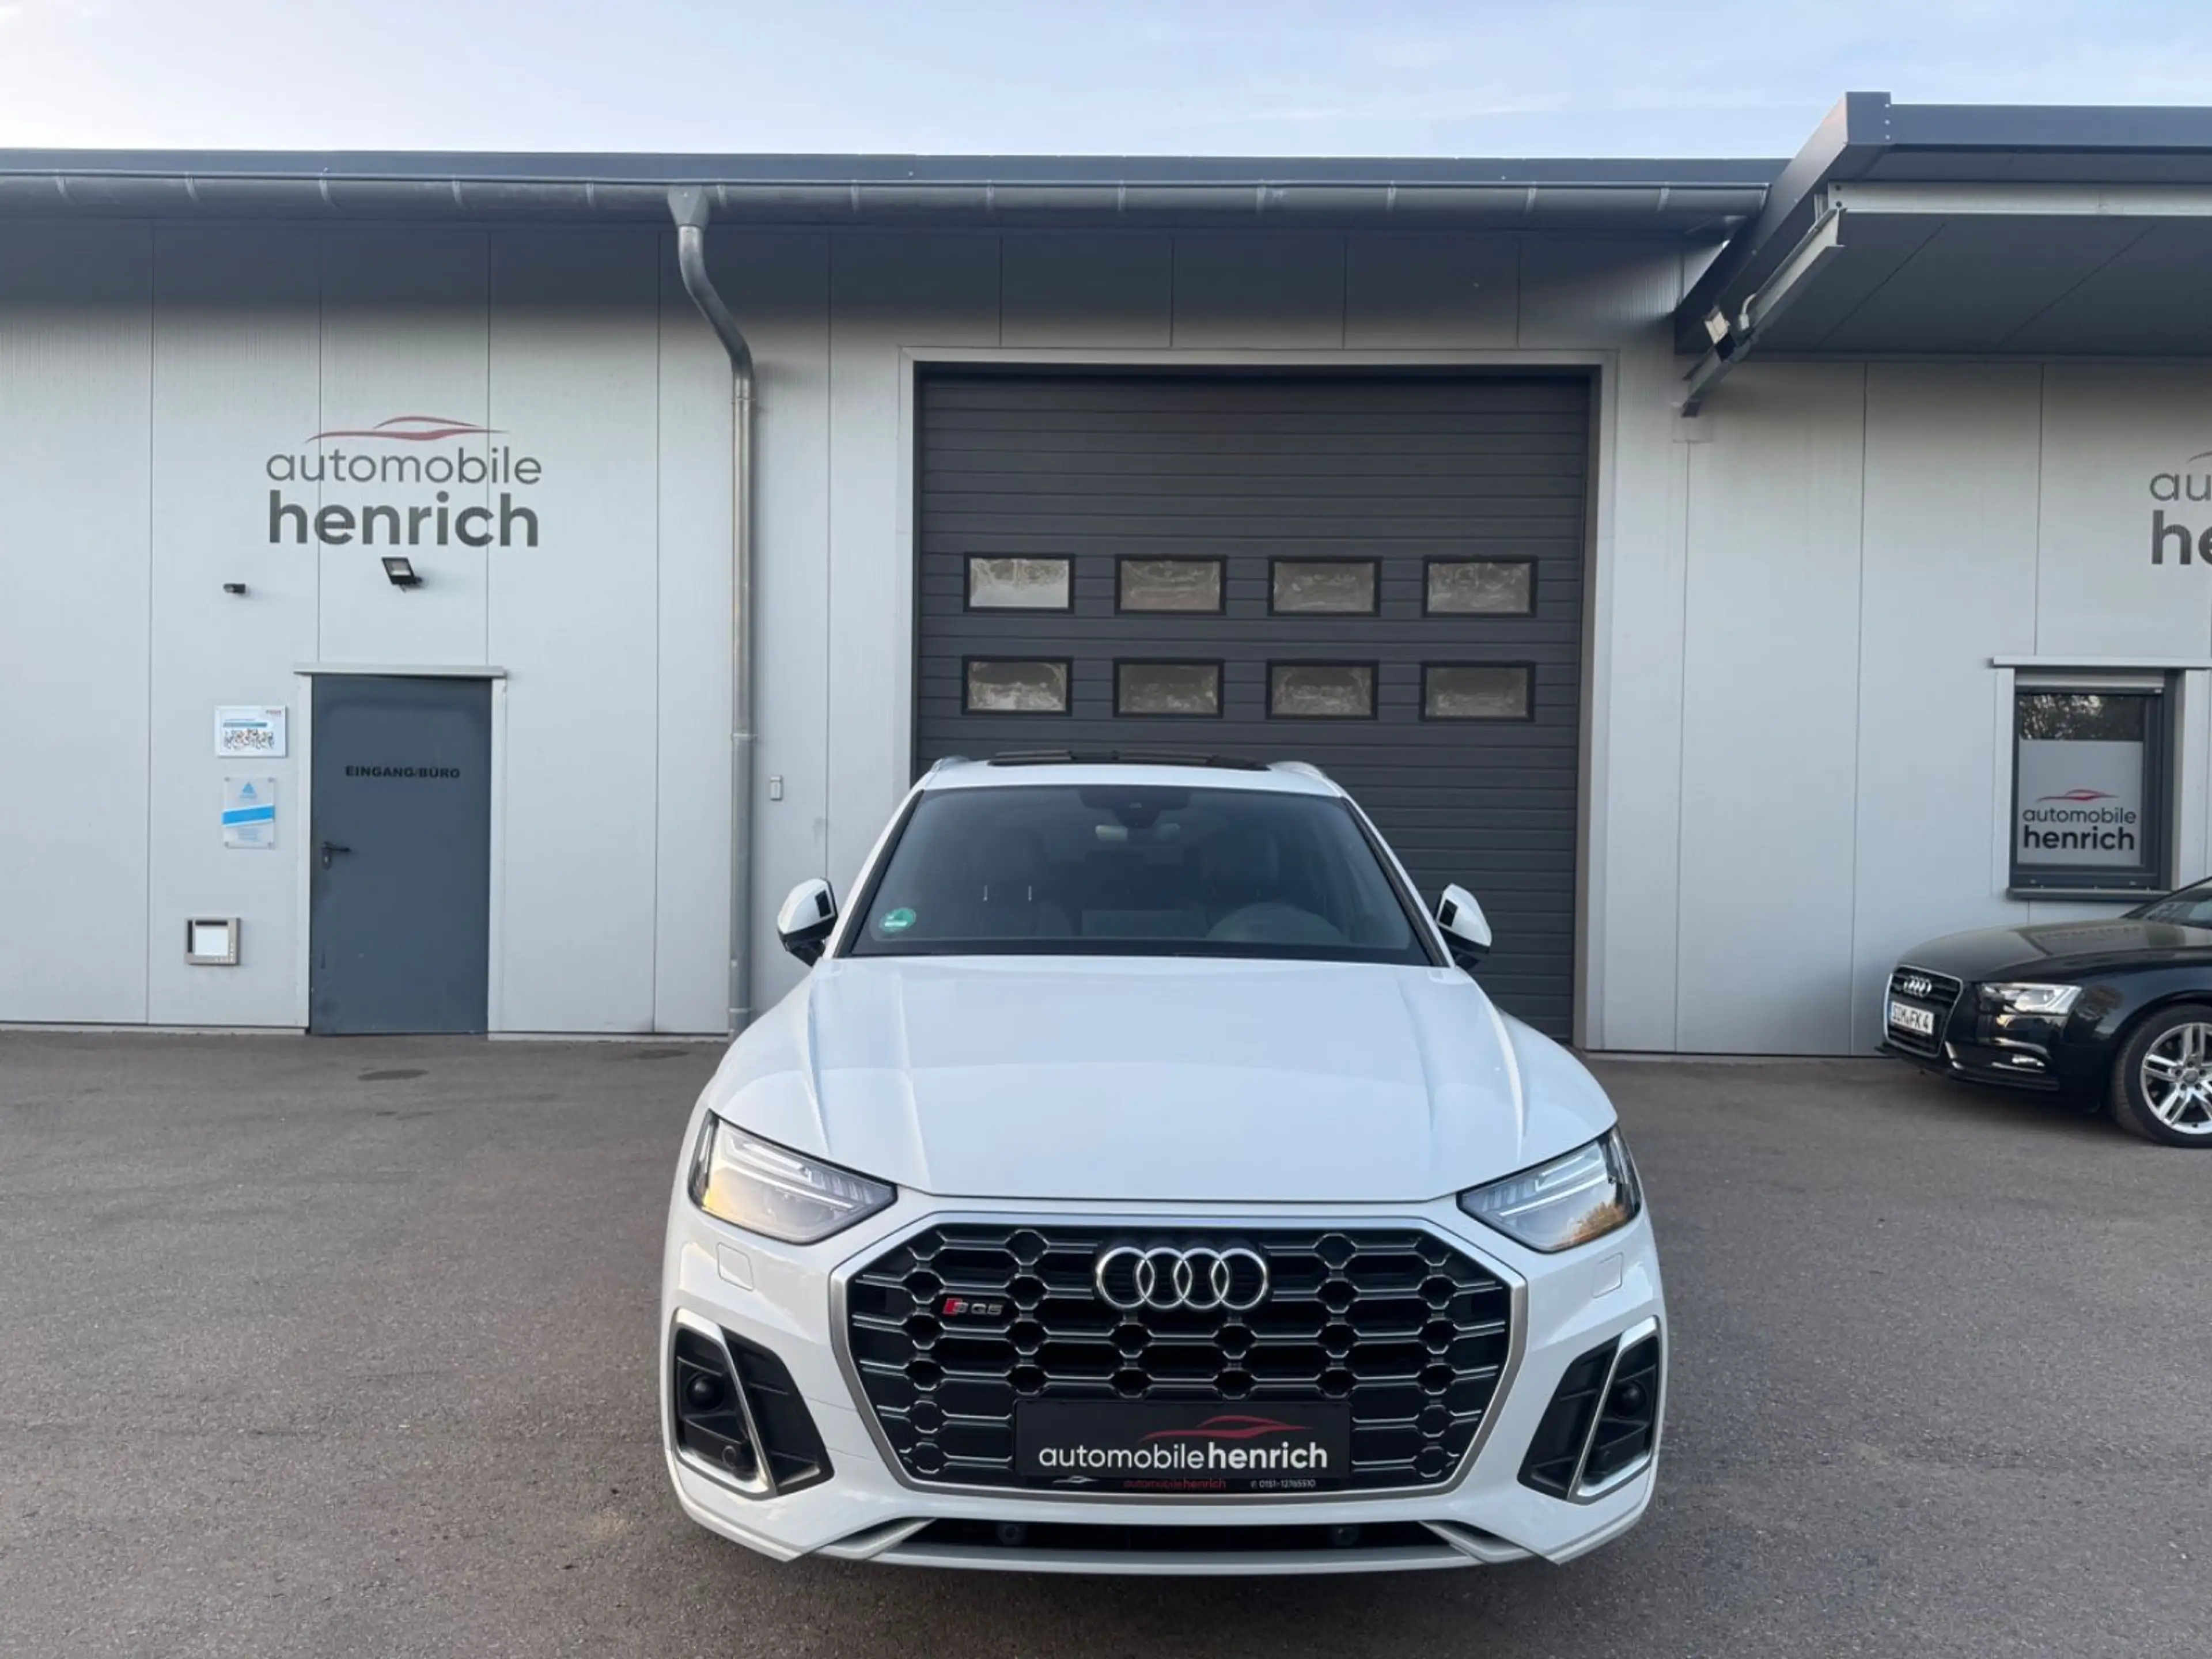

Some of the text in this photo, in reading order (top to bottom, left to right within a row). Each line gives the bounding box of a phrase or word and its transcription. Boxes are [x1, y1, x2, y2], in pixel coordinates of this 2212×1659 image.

[266, 446, 542, 485] automobile
[268, 489, 539, 548] henrich
[2022, 808, 2137, 824] automobile
[2023, 824, 2135, 851] henrich
